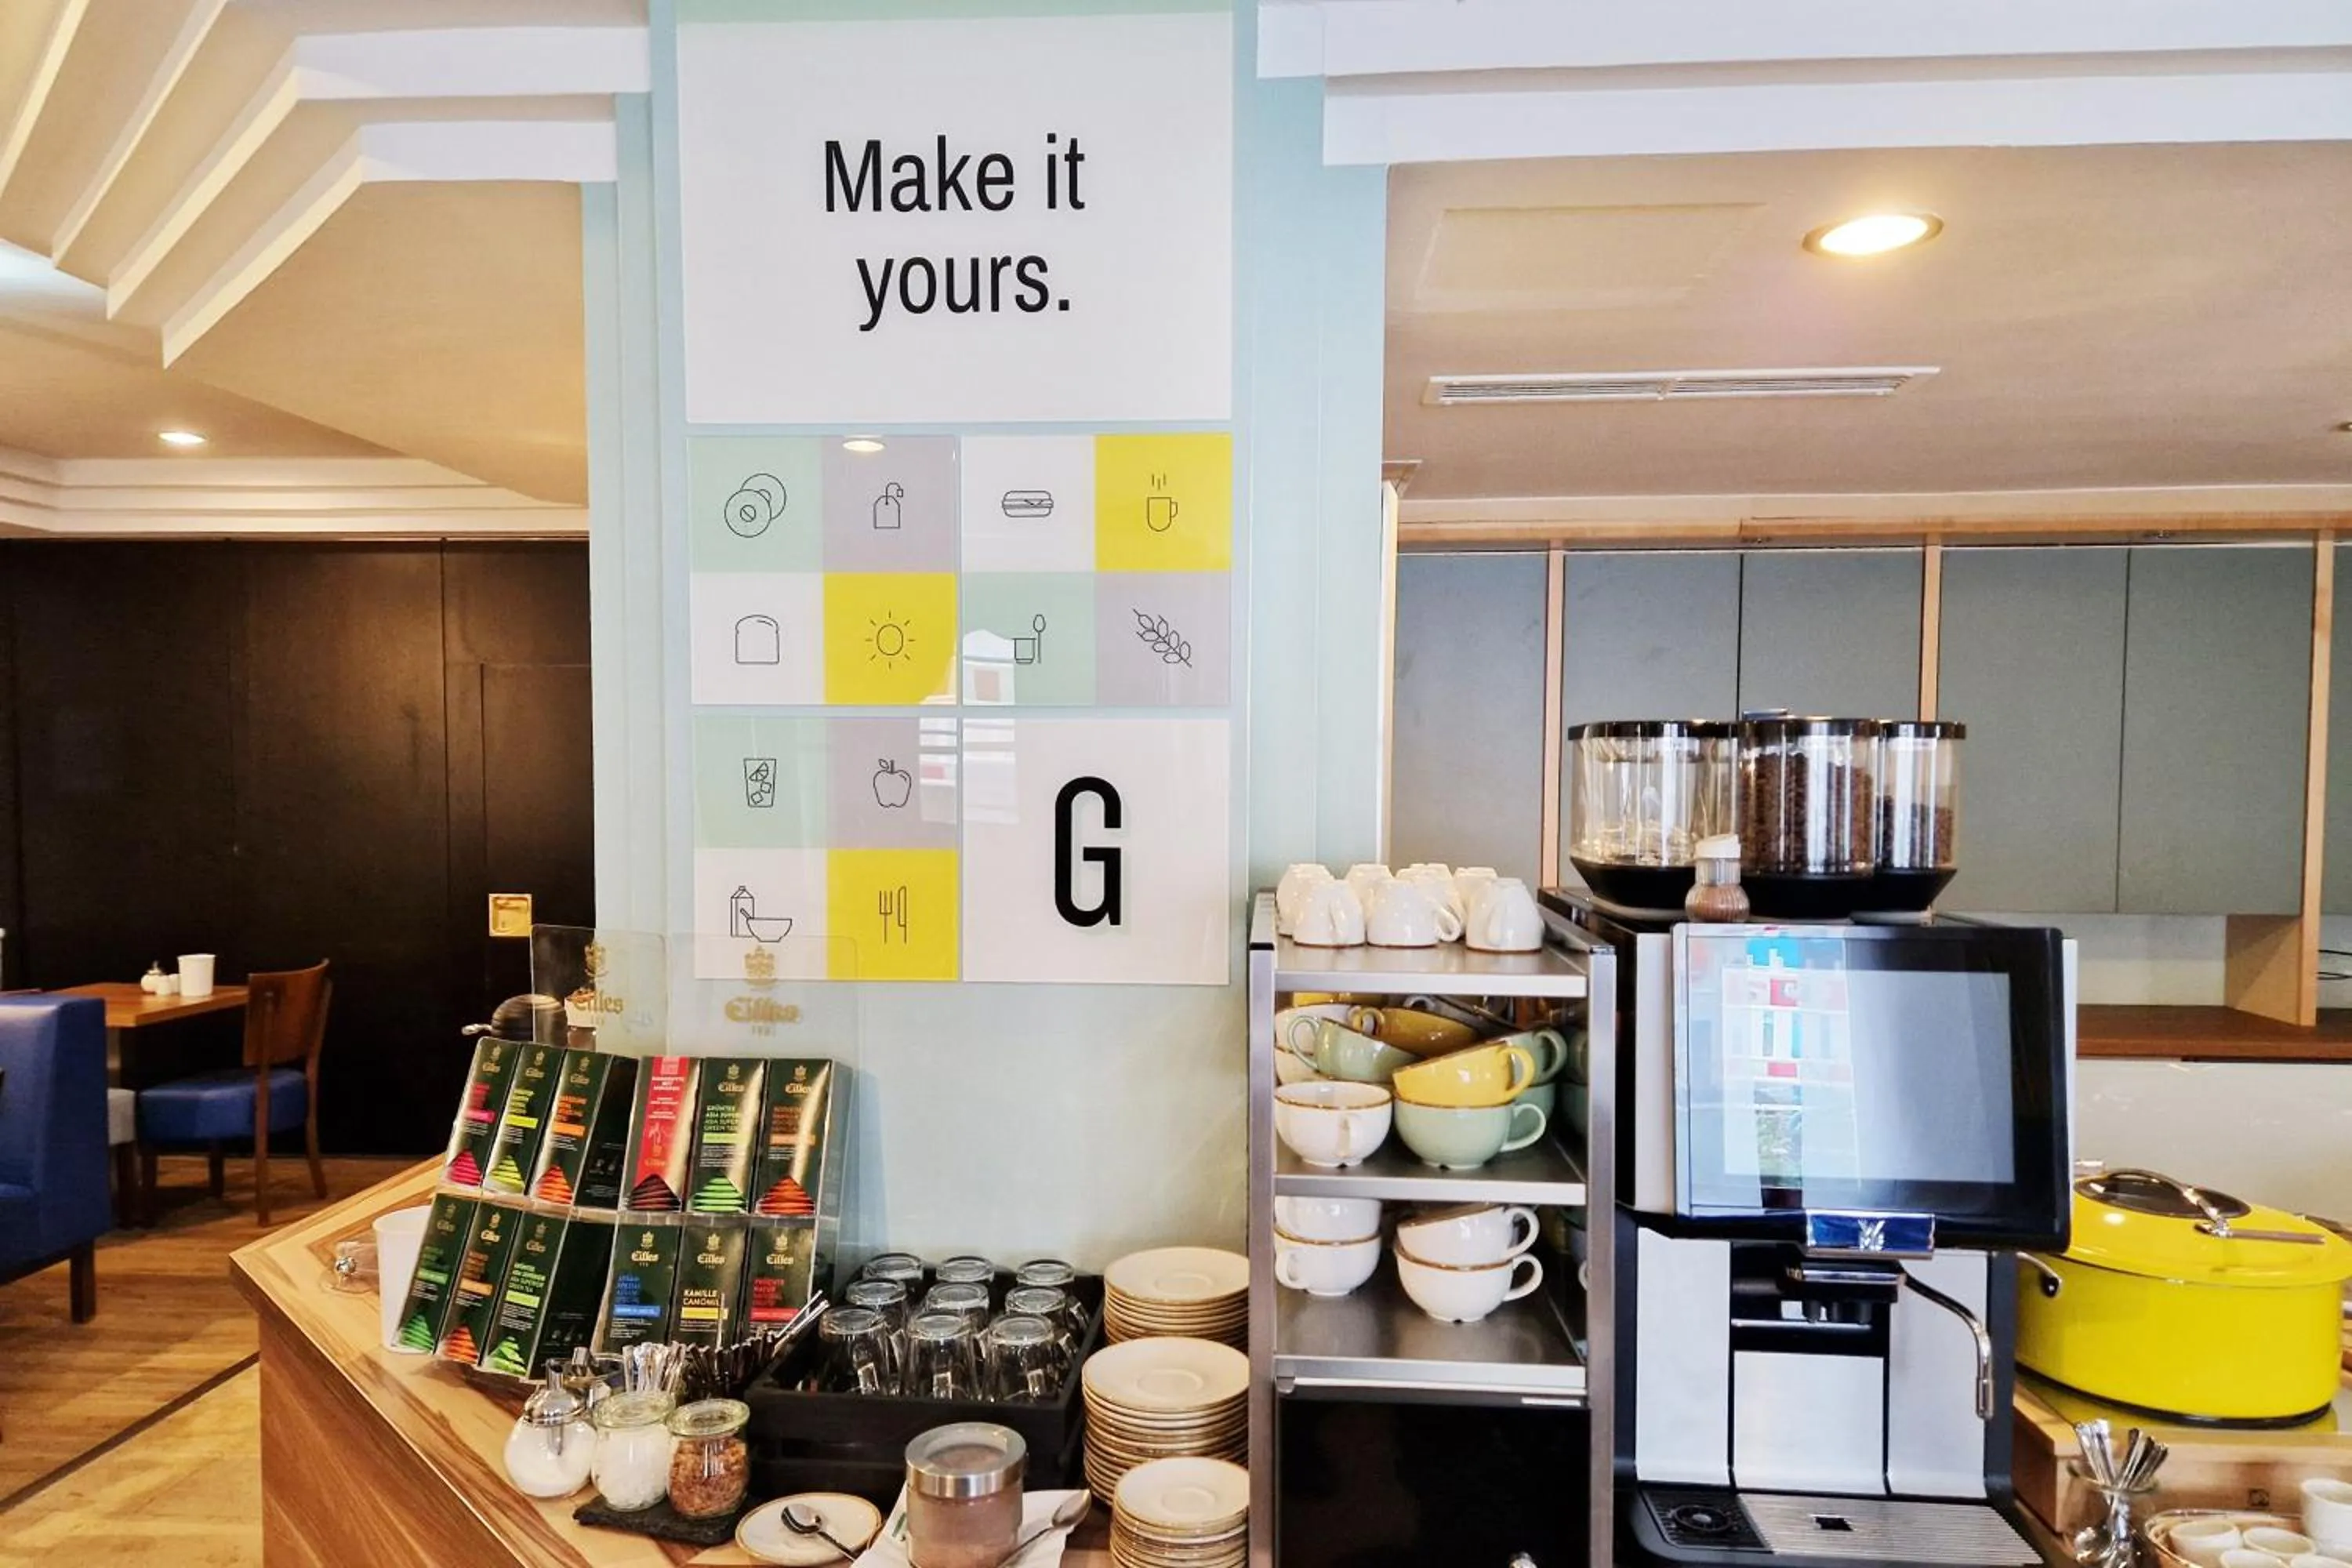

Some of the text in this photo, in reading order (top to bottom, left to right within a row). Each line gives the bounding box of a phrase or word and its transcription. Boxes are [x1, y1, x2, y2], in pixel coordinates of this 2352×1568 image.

[824, 132, 1086, 213] Make it
[856, 255, 1071, 332] yours.
[1054, 776, 1122, 927] G
[573, 992, 624, 1016] Eilles
[631, 1250, 659, 1262] Eilles
[697, 1253, 726, 1265] Eilles
[766, 1254, 794, 1265] Eilles
[684, 1289, 718, 1298] KAMILLE
